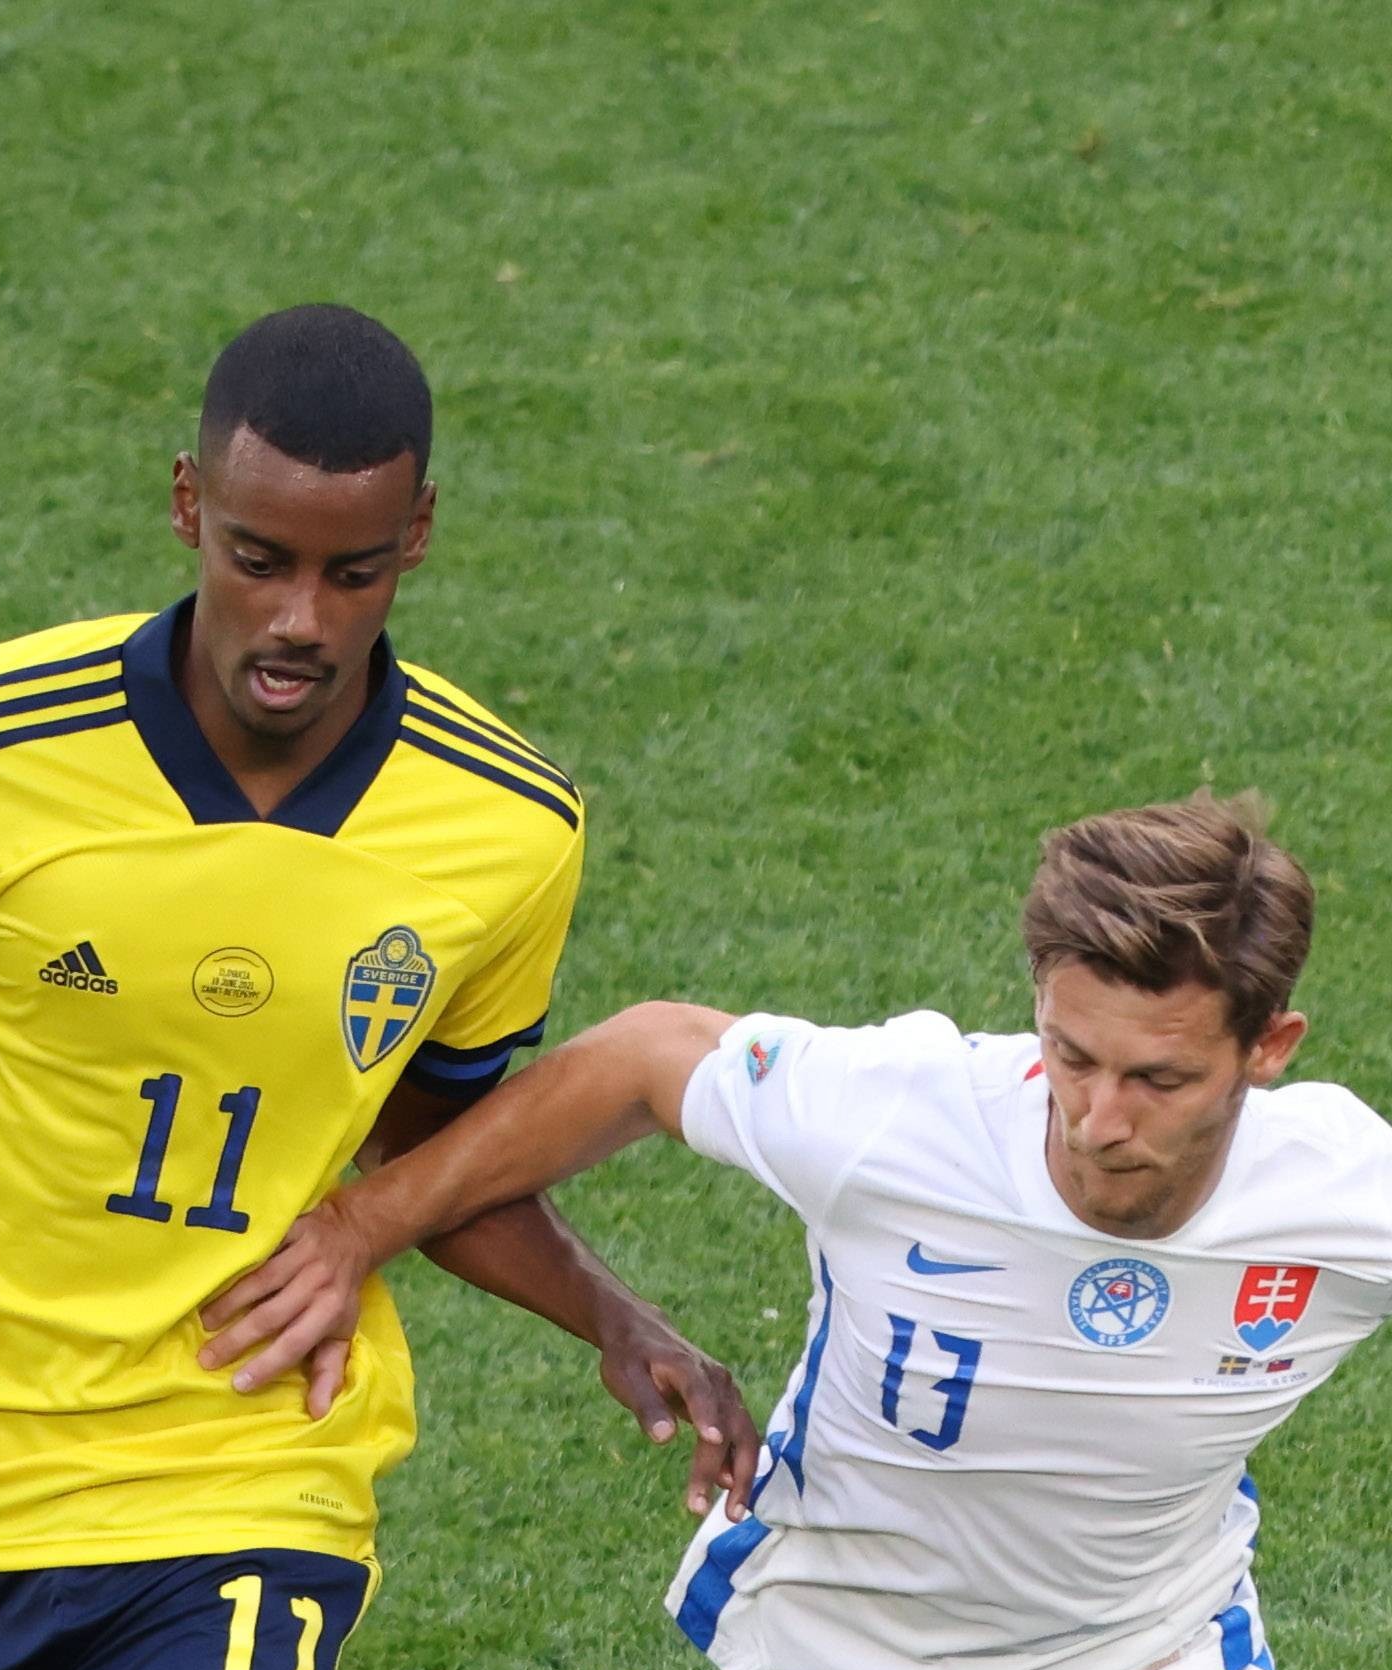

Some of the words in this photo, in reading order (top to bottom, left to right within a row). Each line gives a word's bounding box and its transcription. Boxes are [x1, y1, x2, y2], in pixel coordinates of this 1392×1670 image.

[39, 968, 118, 995] adidas
[362, 969, 419, 984] SVERIGE
[106, 1072, 261, 1234] 11
[1098, 1334, 1127, 1345] SFZ
[880, 1313, 983, 1452] 13
